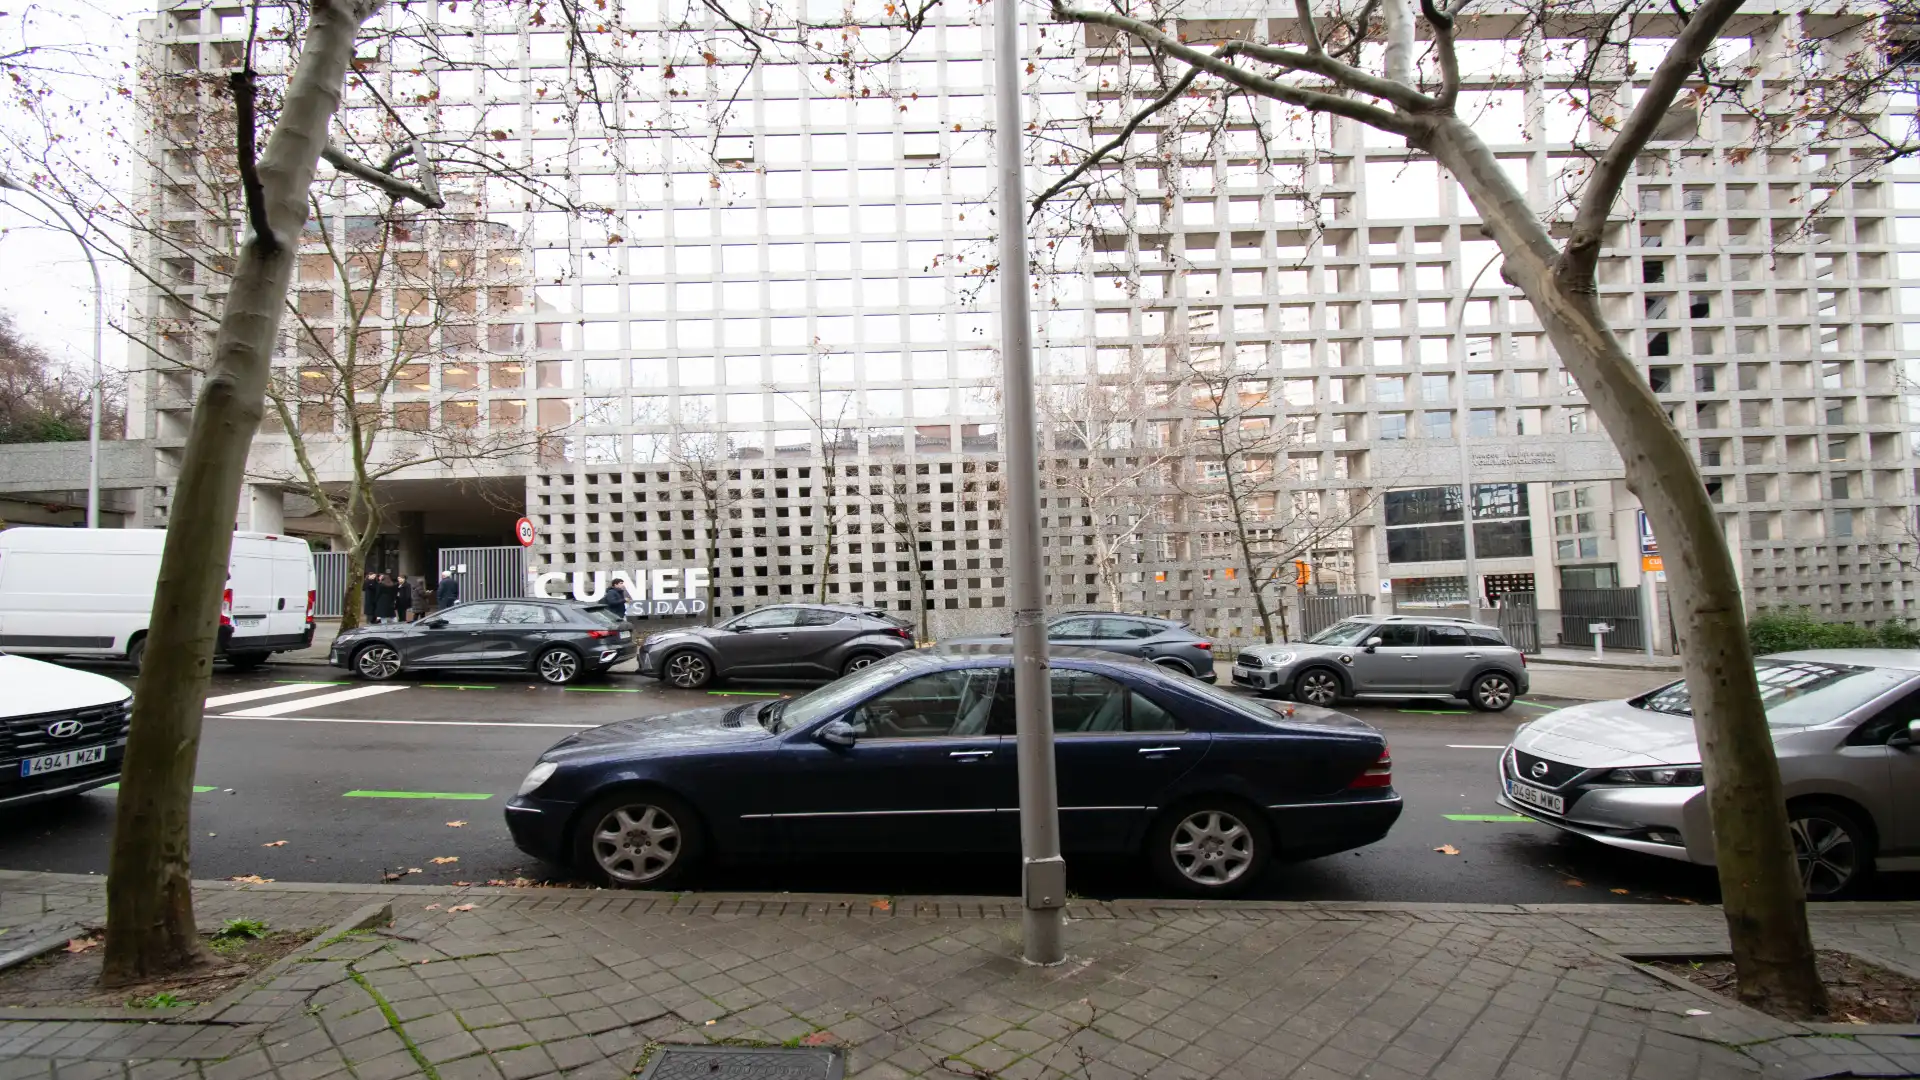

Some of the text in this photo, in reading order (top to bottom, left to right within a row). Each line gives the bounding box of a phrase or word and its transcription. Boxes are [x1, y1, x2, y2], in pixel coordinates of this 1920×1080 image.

[521, 527, 532, 537] 30
[534, 567, 710, 602] CUNEF
[625, 600, 706, 615] SIDAD
[33, 747, 102, 772] 4941 MZW
[1513, 783, 1561, 810] 0495 MWC
